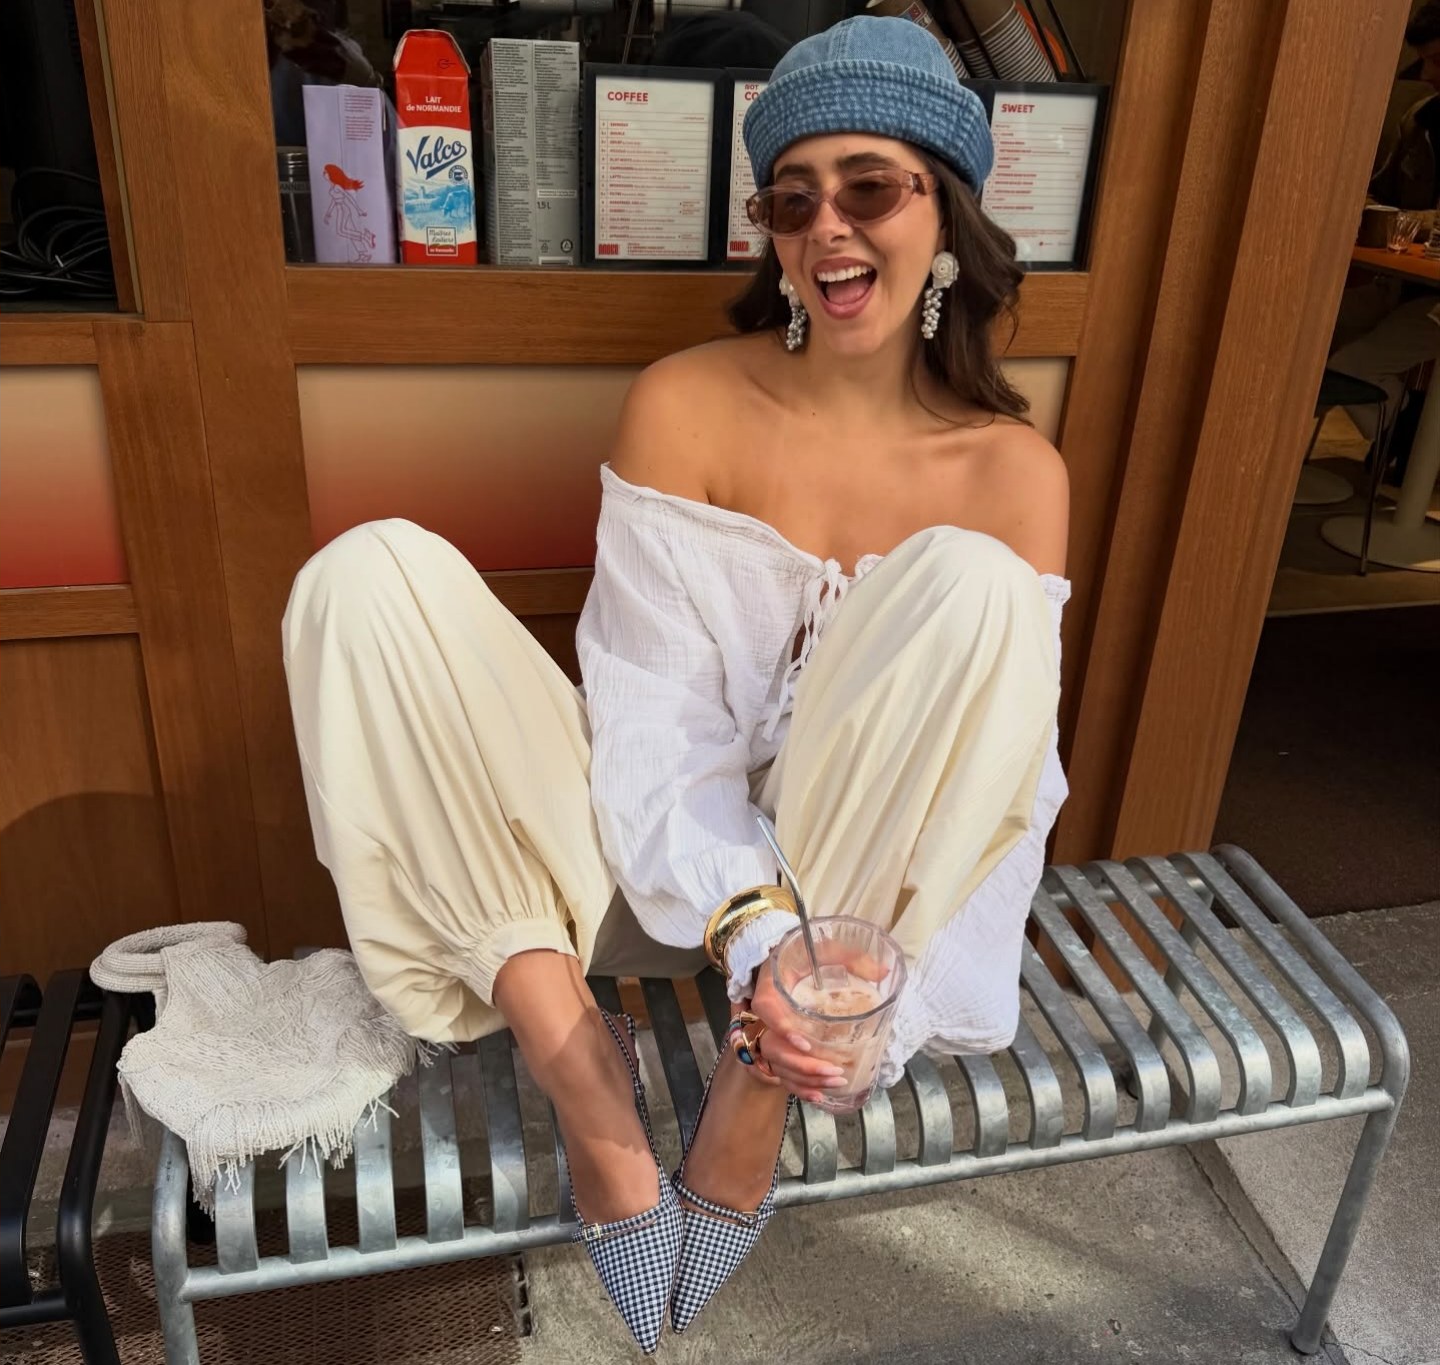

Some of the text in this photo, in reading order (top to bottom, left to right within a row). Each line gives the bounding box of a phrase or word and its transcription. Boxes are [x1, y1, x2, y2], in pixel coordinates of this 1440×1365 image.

[425, 96, 442, 104] LAIT
[607, 91, 649, 102] COFFEE
[416, 105, 462, 113] NORMANDIE
[1000, 103, 1036, 114] SWEET
[406, 135, 467, 179] Valco
